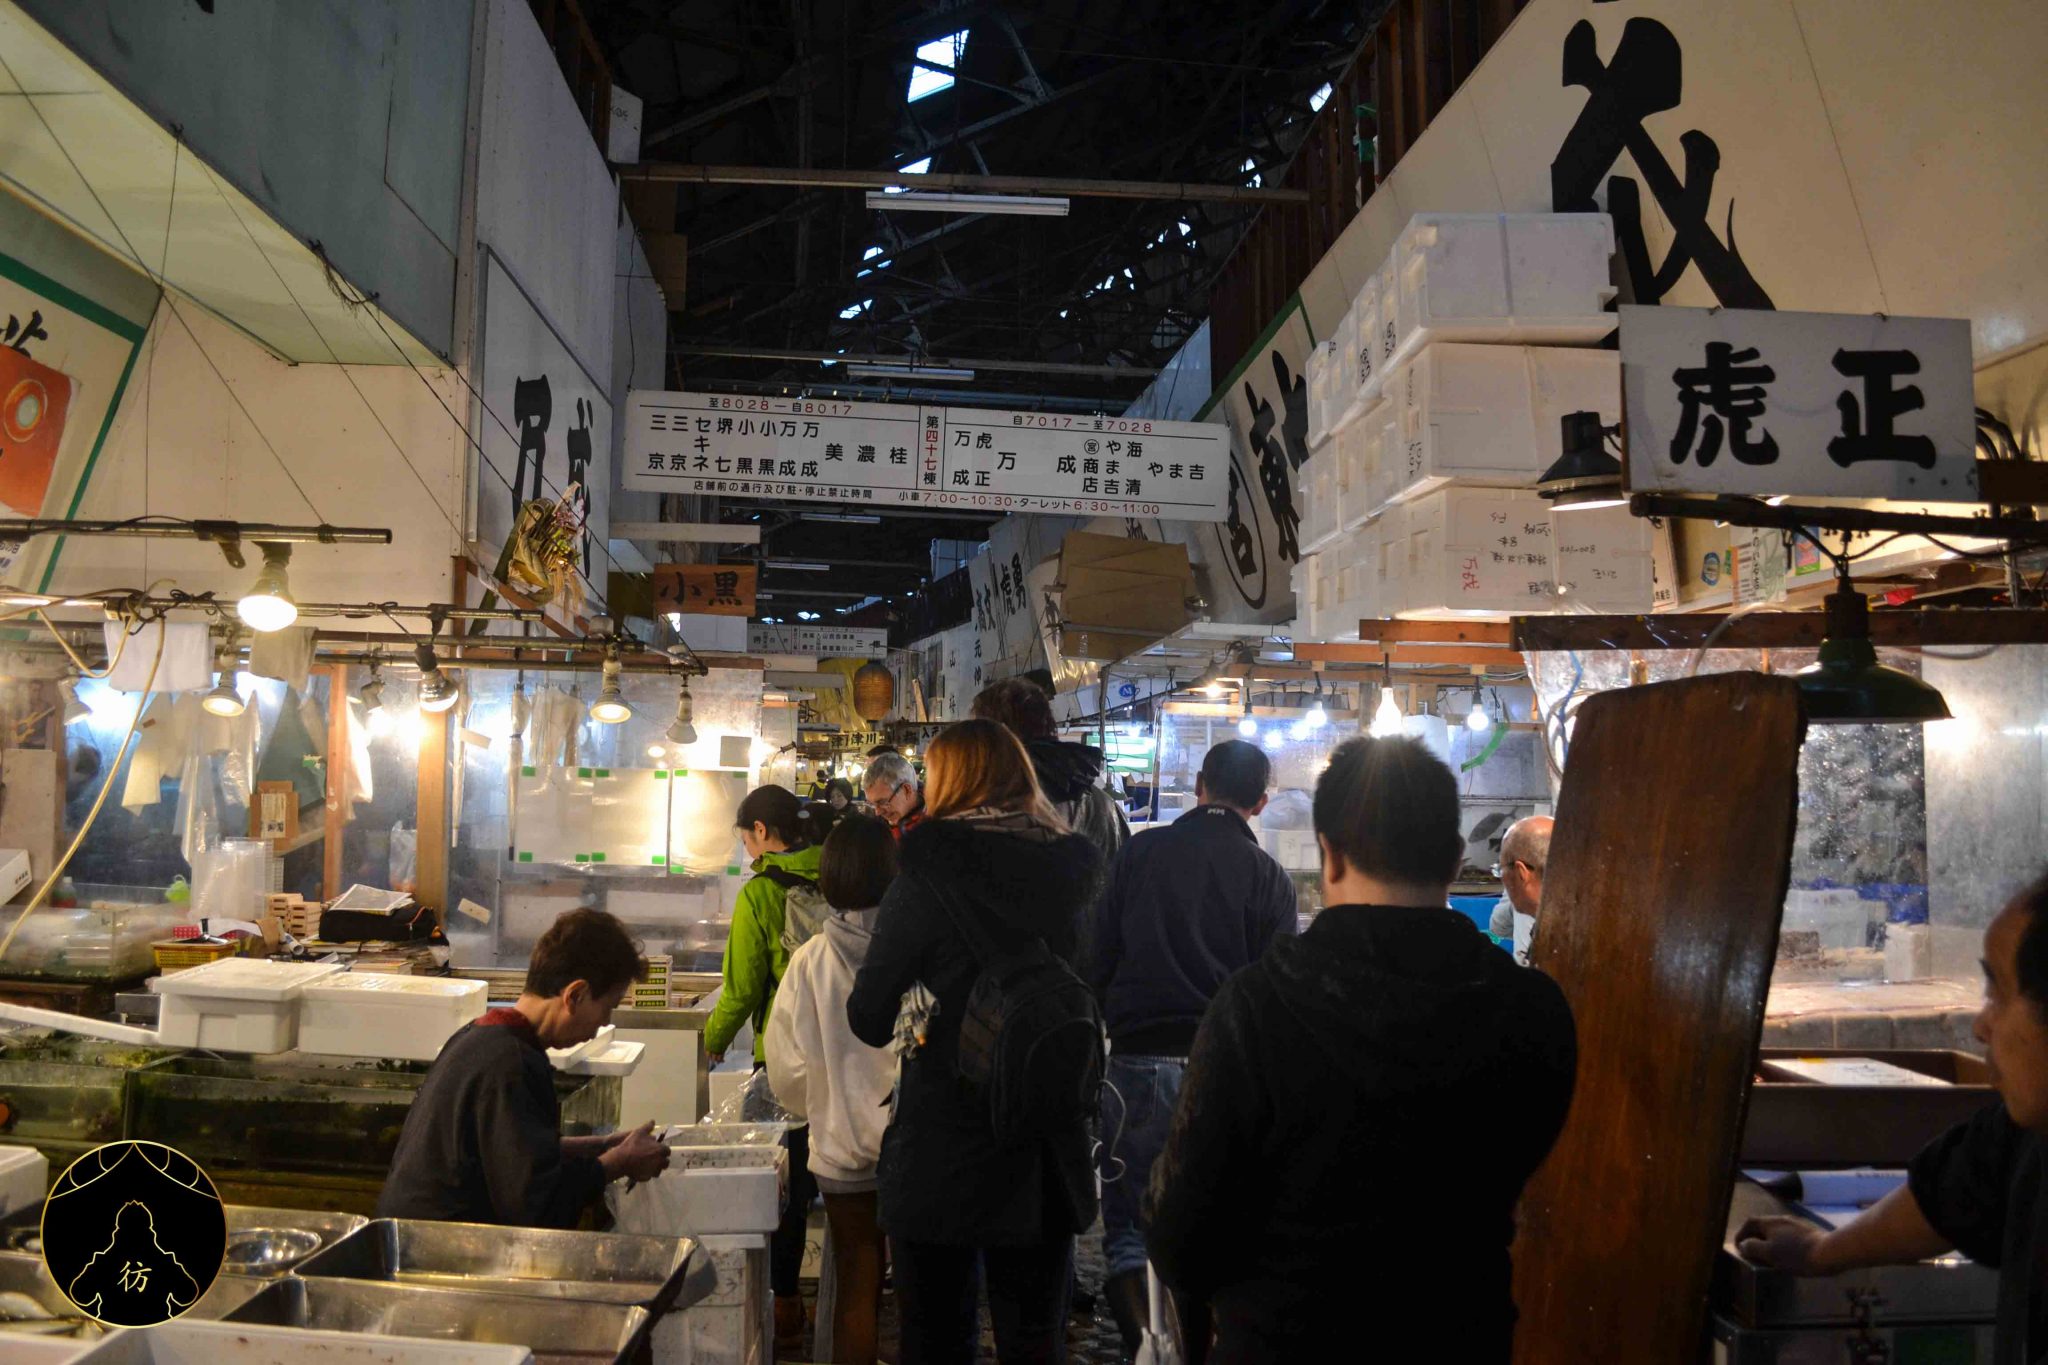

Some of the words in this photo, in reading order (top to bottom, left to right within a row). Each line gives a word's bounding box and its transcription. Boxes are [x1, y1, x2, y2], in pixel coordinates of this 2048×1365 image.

[1670, 341, 1937, 469] 虎正
[825, 443, 907, 464] 美濃桂
[659, 571, 743, 606] 小黒
